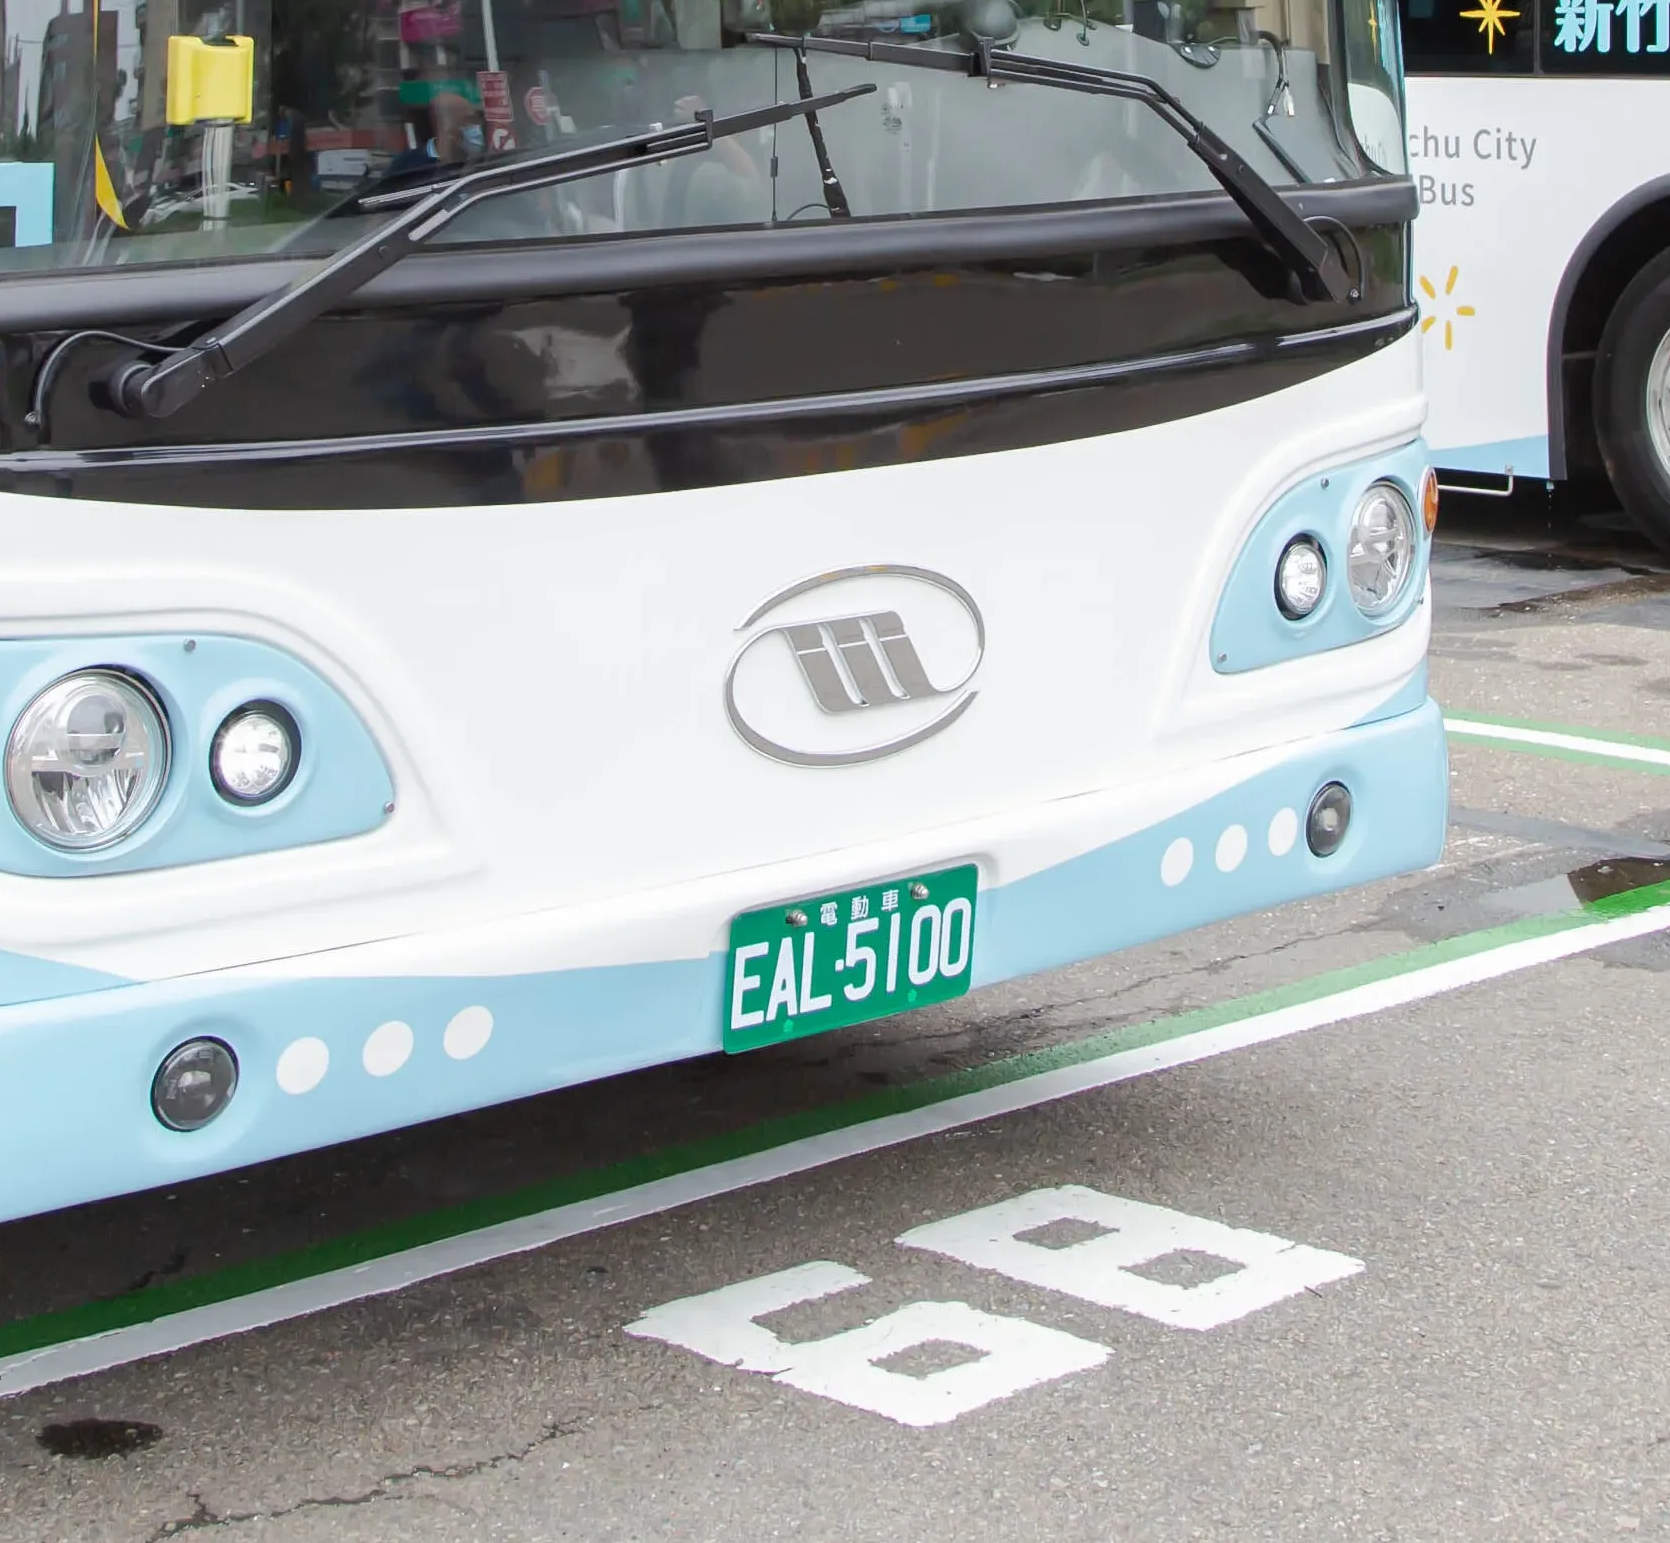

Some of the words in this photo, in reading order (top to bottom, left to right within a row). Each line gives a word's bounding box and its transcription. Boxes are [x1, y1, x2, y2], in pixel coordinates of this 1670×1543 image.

[1473, 128, 1537, 170] City
[1419, 175, 1475, 207] Bus
[819, 888, 900, 927] 電動車
[623, 1183, 1366, 1427] 68
